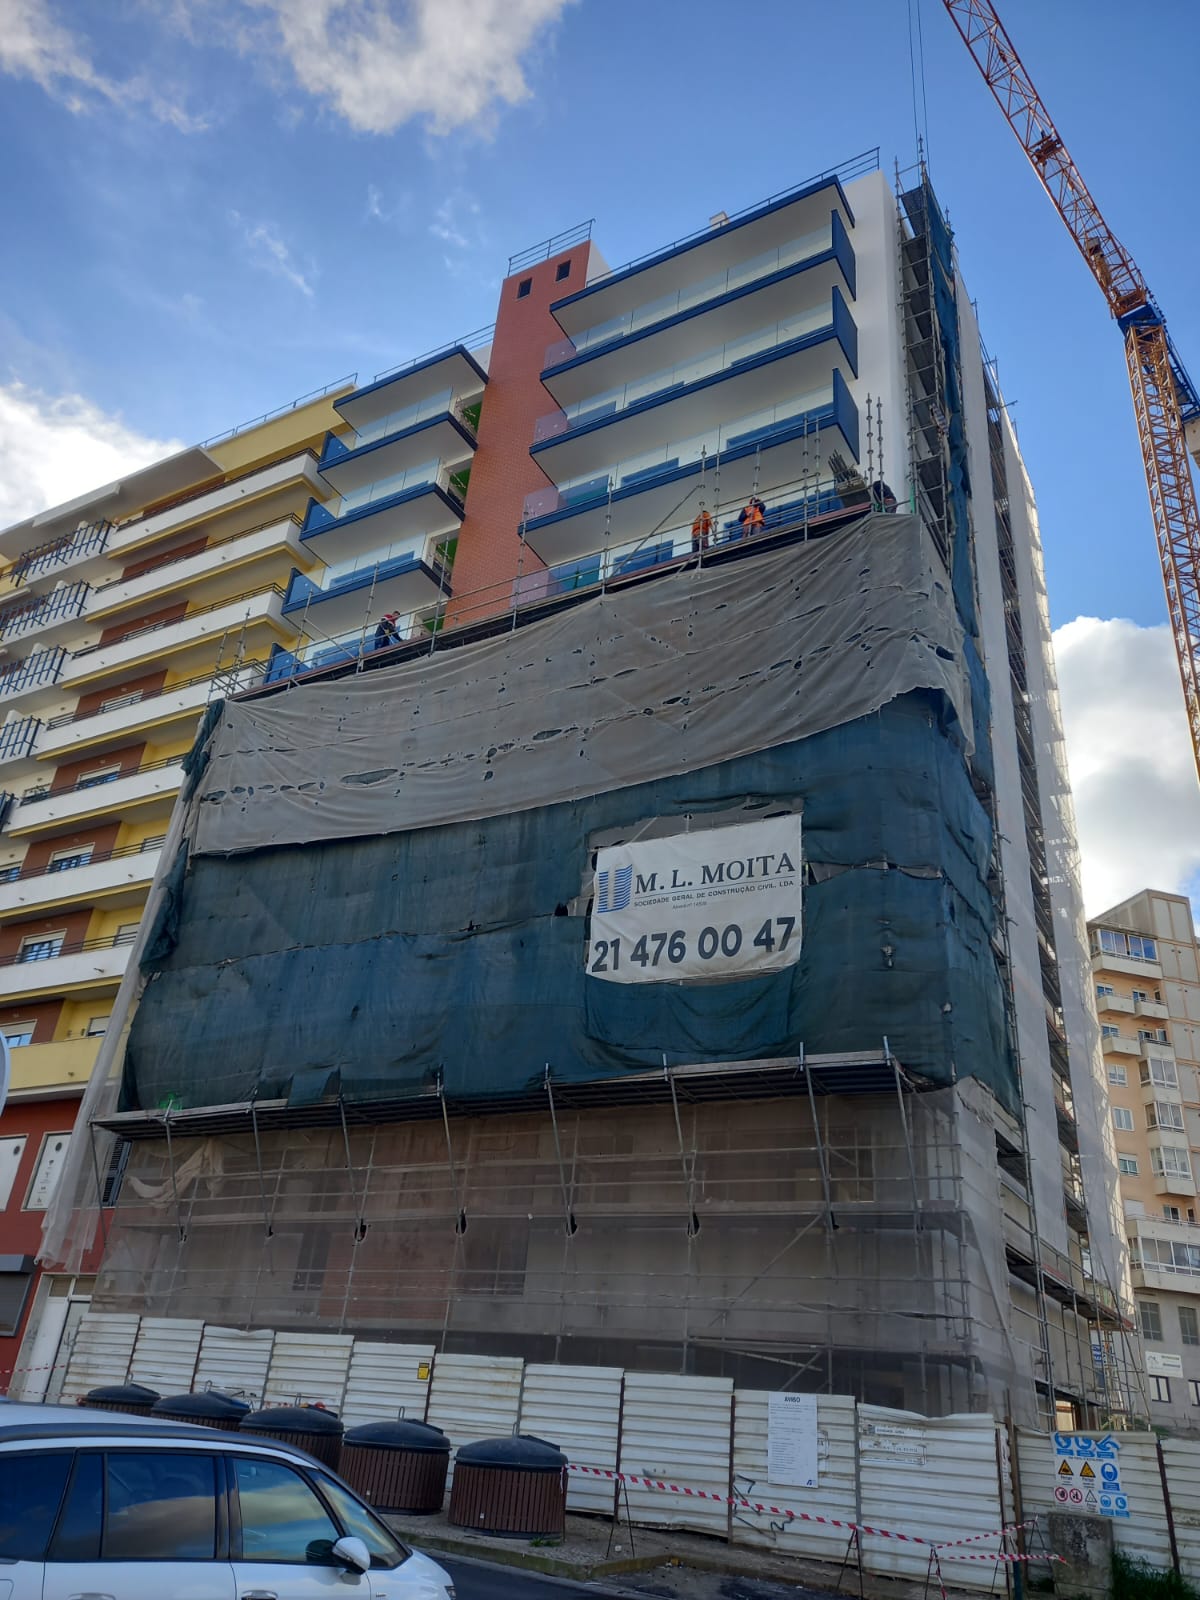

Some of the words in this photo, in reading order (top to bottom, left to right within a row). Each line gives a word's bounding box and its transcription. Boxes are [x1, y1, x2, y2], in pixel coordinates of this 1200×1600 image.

[634, 872, 664, 894] M.
[671, 869, 693, 888] L.
[701, 852, 796, 885] MOITA
[633, 896, 670, 907] SOCIEDADE
[671, 893, 694, 902] GERAL
[707, 885, 756, 897] CONSTRUÇÃO
[591, 938, 621, 973] 21
[630, 930, 687, 967] 476
[697, 923, 743, 960] 00
[753, 916, 796, 953] 47
